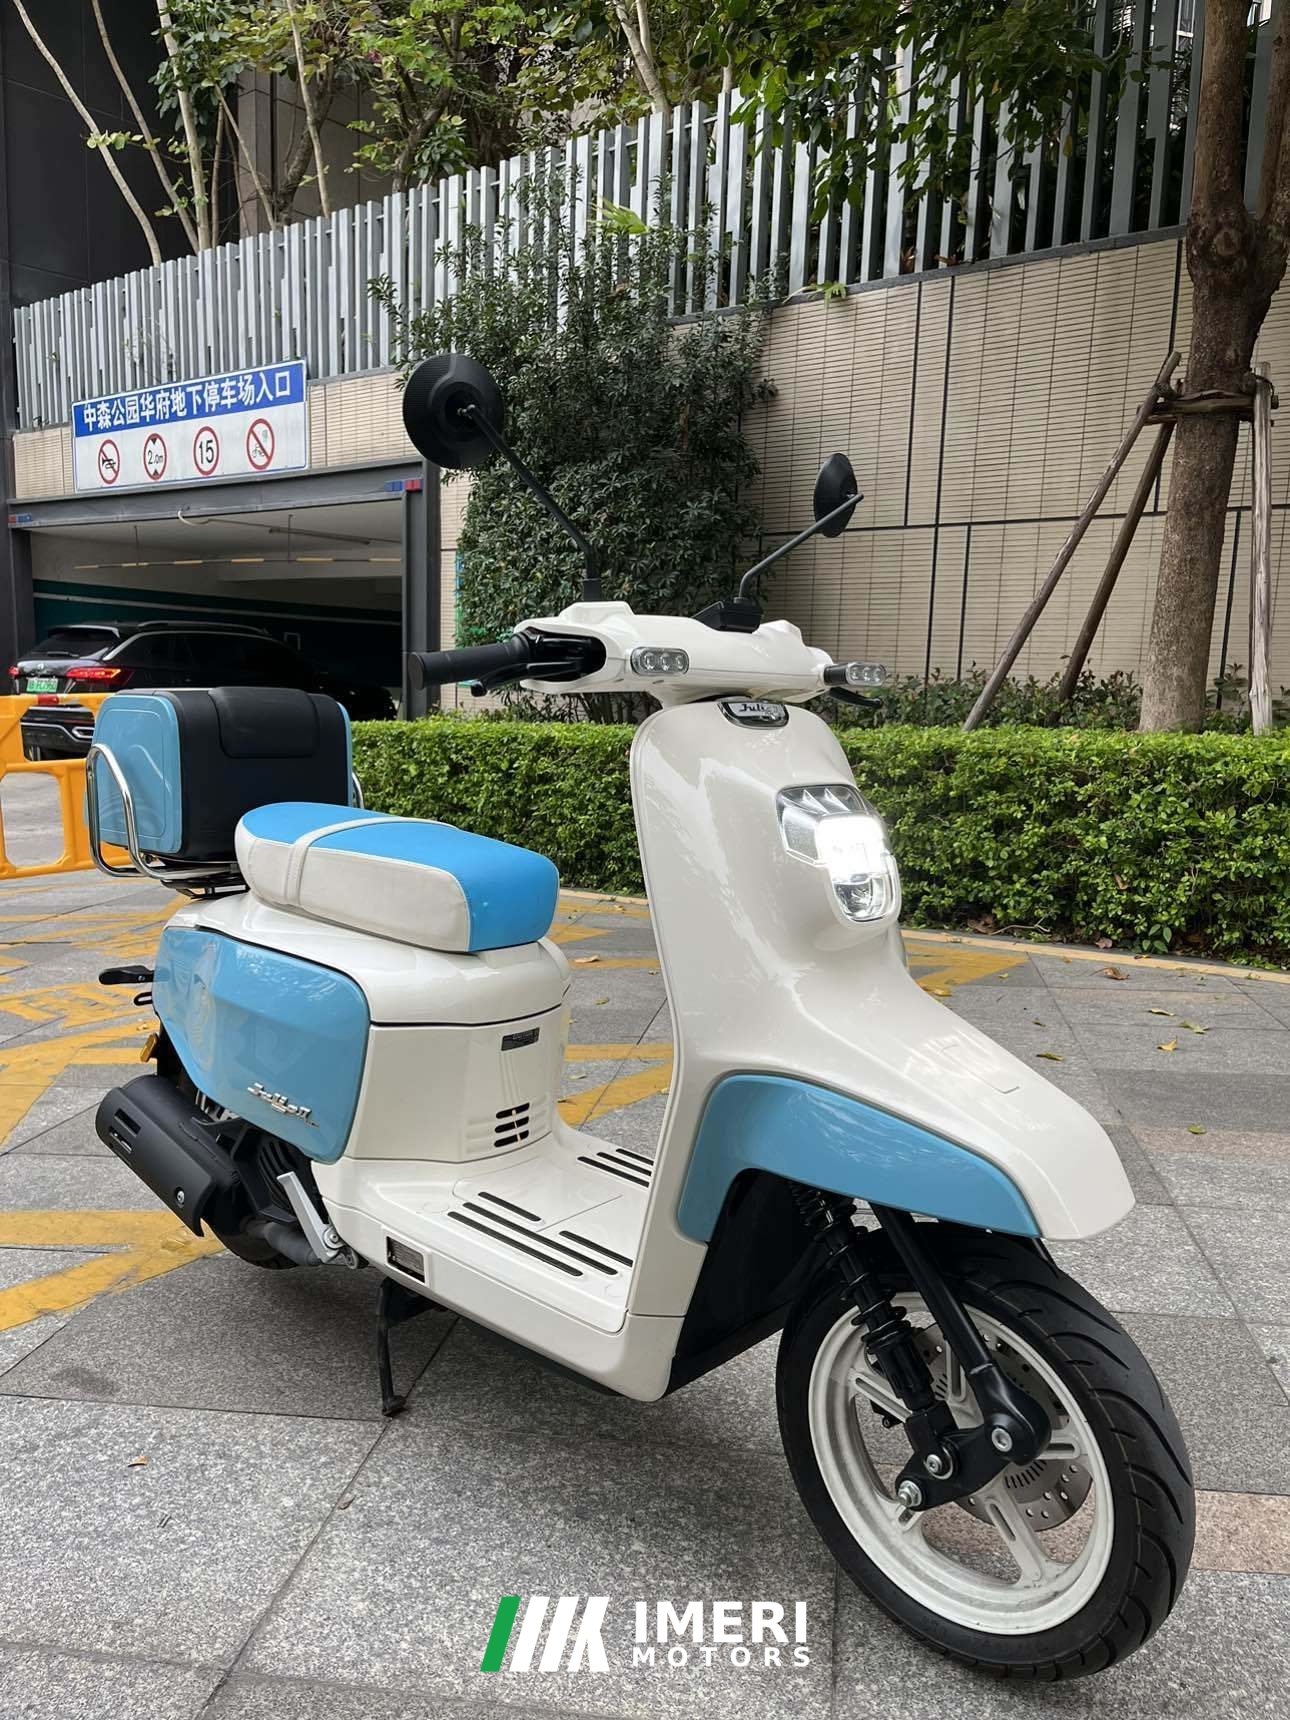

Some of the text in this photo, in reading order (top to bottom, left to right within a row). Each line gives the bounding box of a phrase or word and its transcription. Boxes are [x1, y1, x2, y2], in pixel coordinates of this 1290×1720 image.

[84, 371, 291, 432] 中森公园华府地下停车场入口
[198, 440, 214, 464] 15
